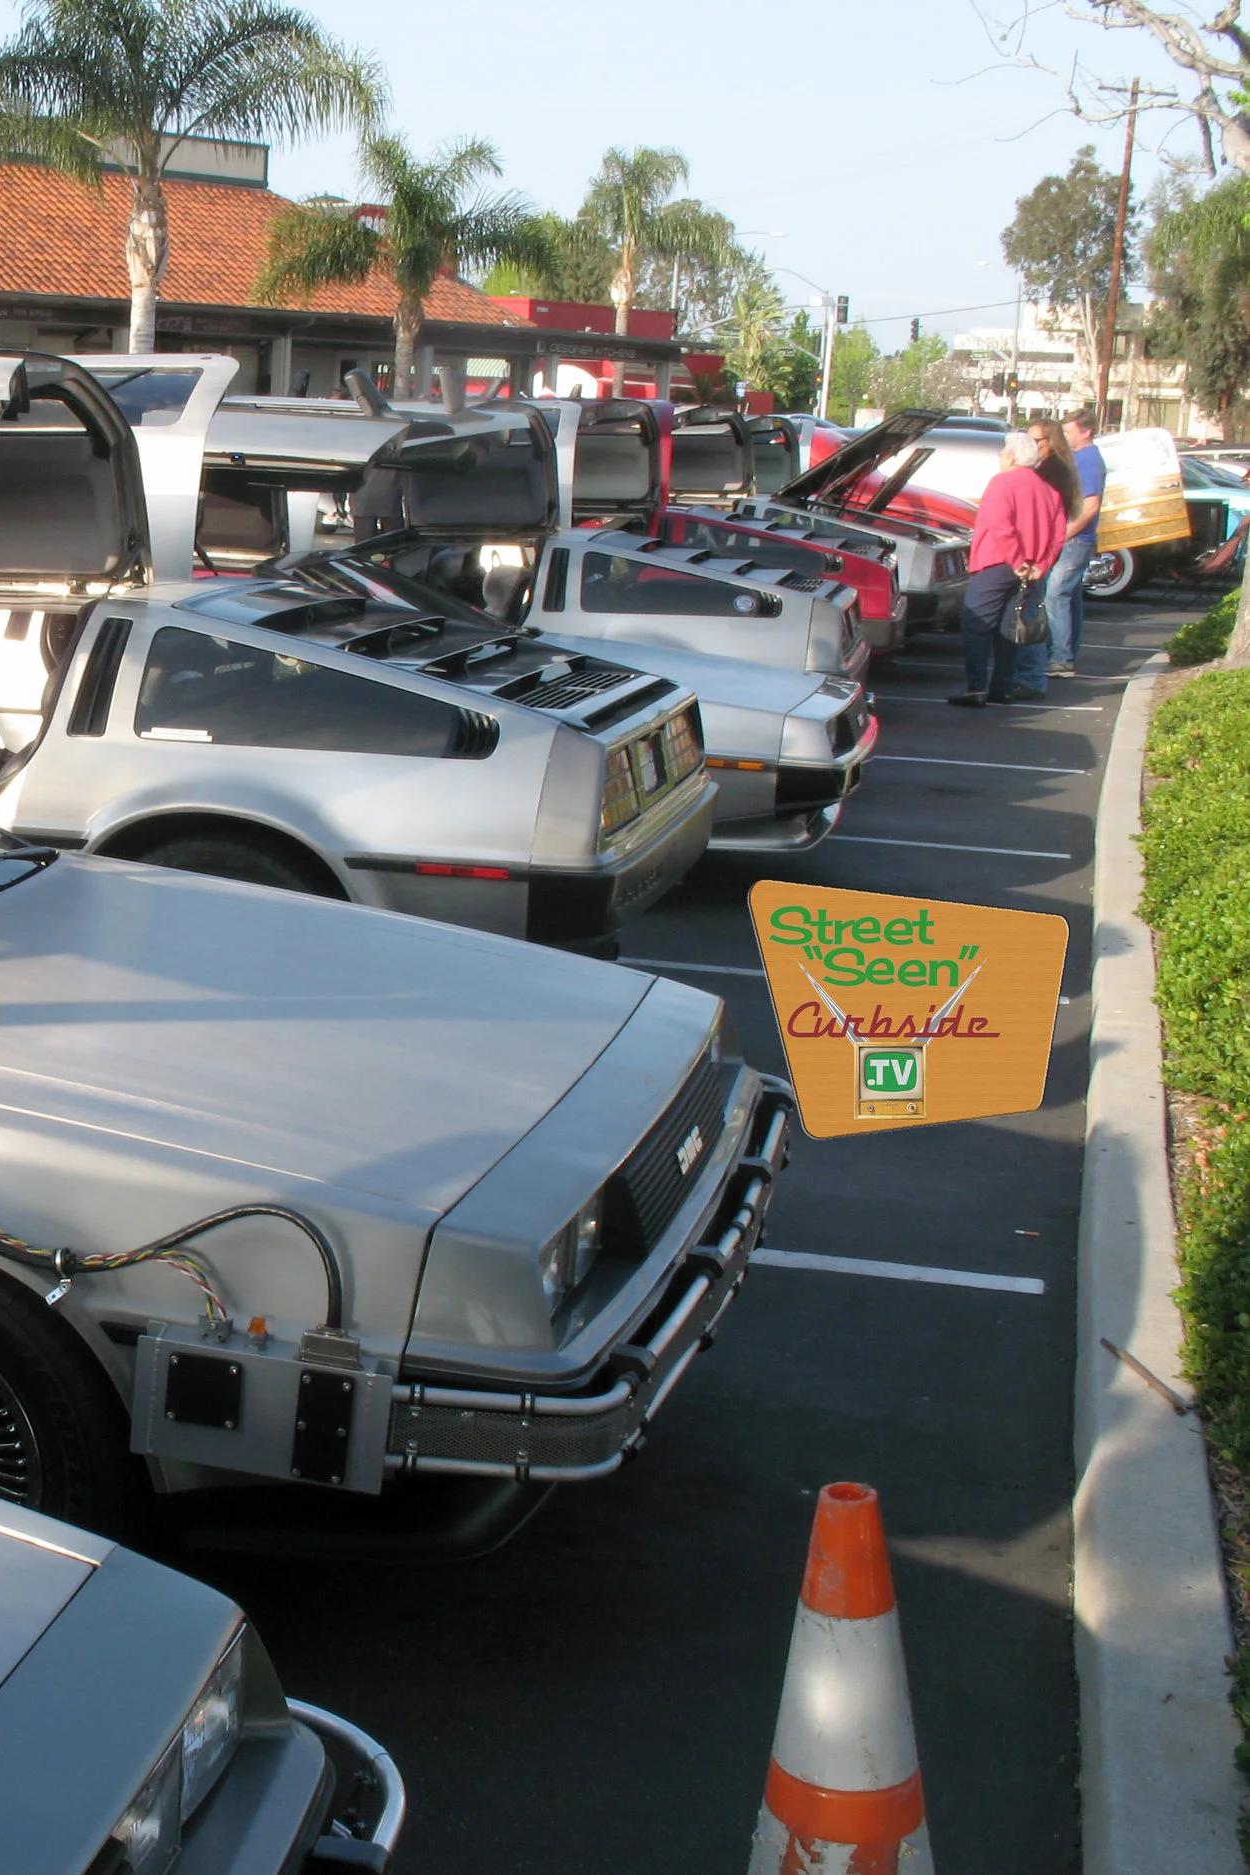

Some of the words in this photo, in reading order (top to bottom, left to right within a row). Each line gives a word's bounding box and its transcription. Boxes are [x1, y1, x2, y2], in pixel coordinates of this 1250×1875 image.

[550, 342, 593, 355] DESIGNER
[594, 346, 636, 359] KITCHENS
[677, 1125, 703, 1175] DMC
